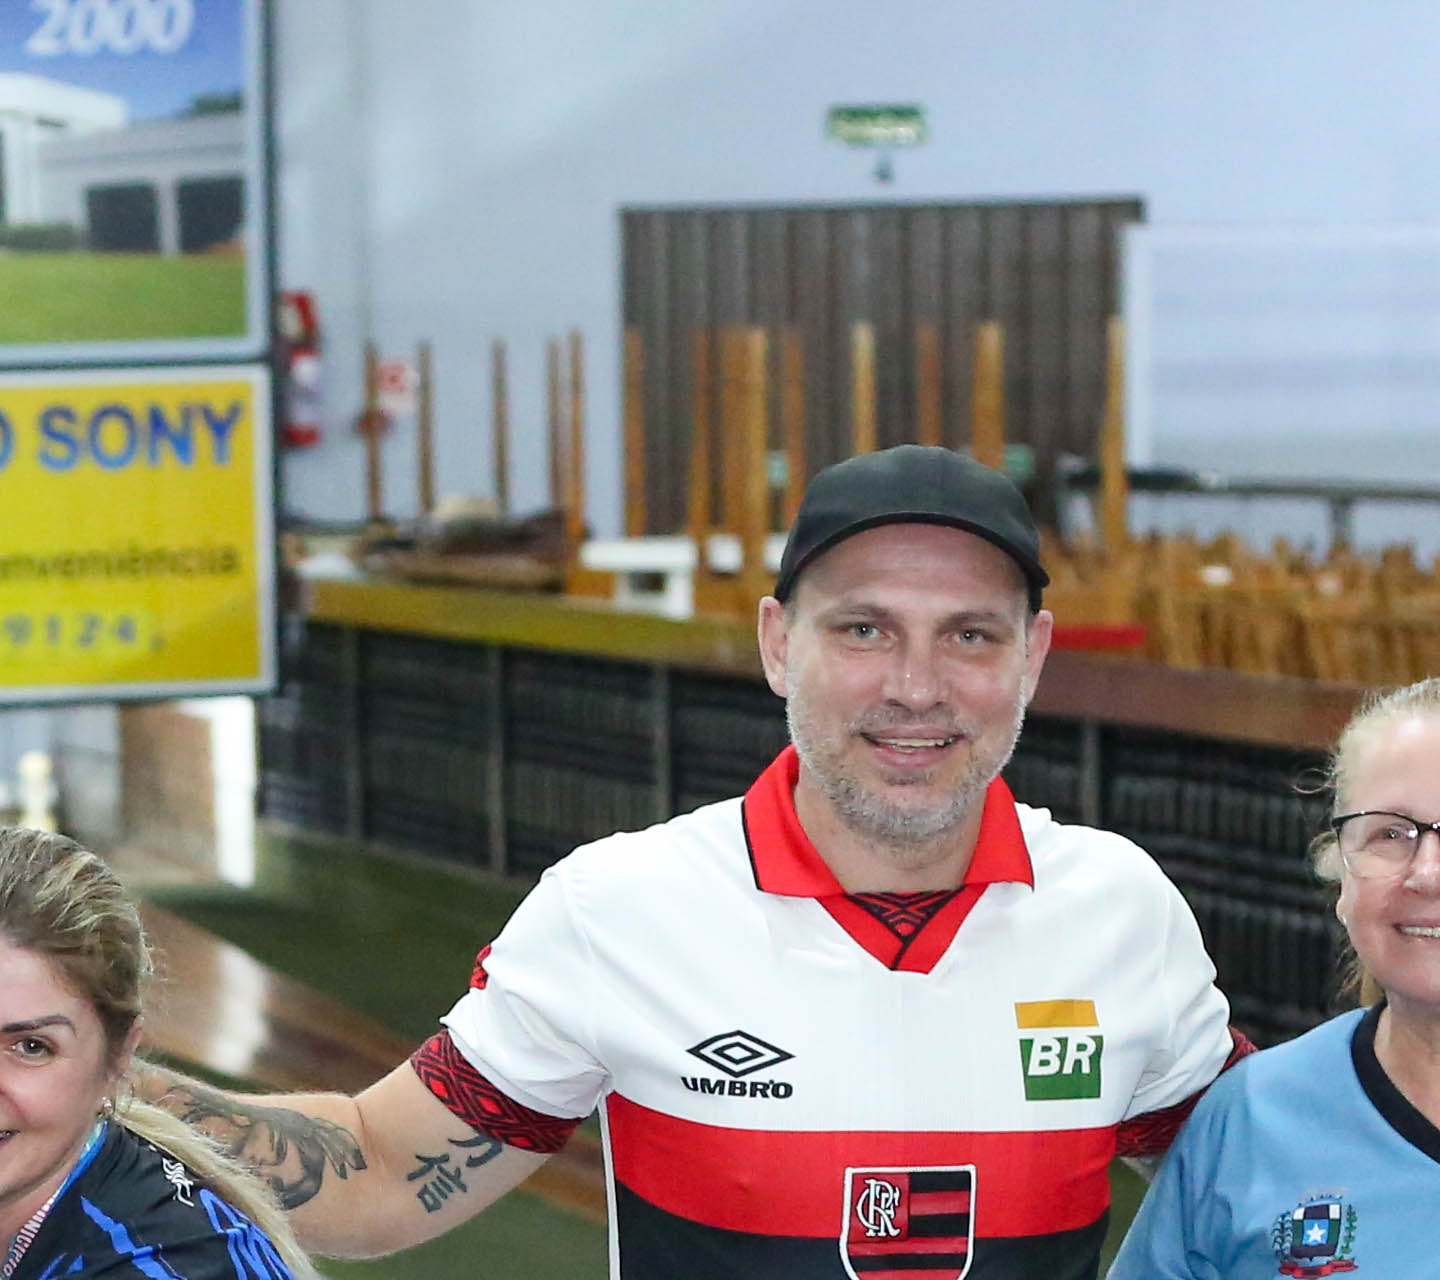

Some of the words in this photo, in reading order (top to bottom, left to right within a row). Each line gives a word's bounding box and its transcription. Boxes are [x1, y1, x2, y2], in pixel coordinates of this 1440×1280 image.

[25, 0, 194, 54] 2000
[38, 400, 244, 473] SONY
[1027, 1035, 1097, 1077] BR
[680, 1076, 794, 1100] UMBRO
